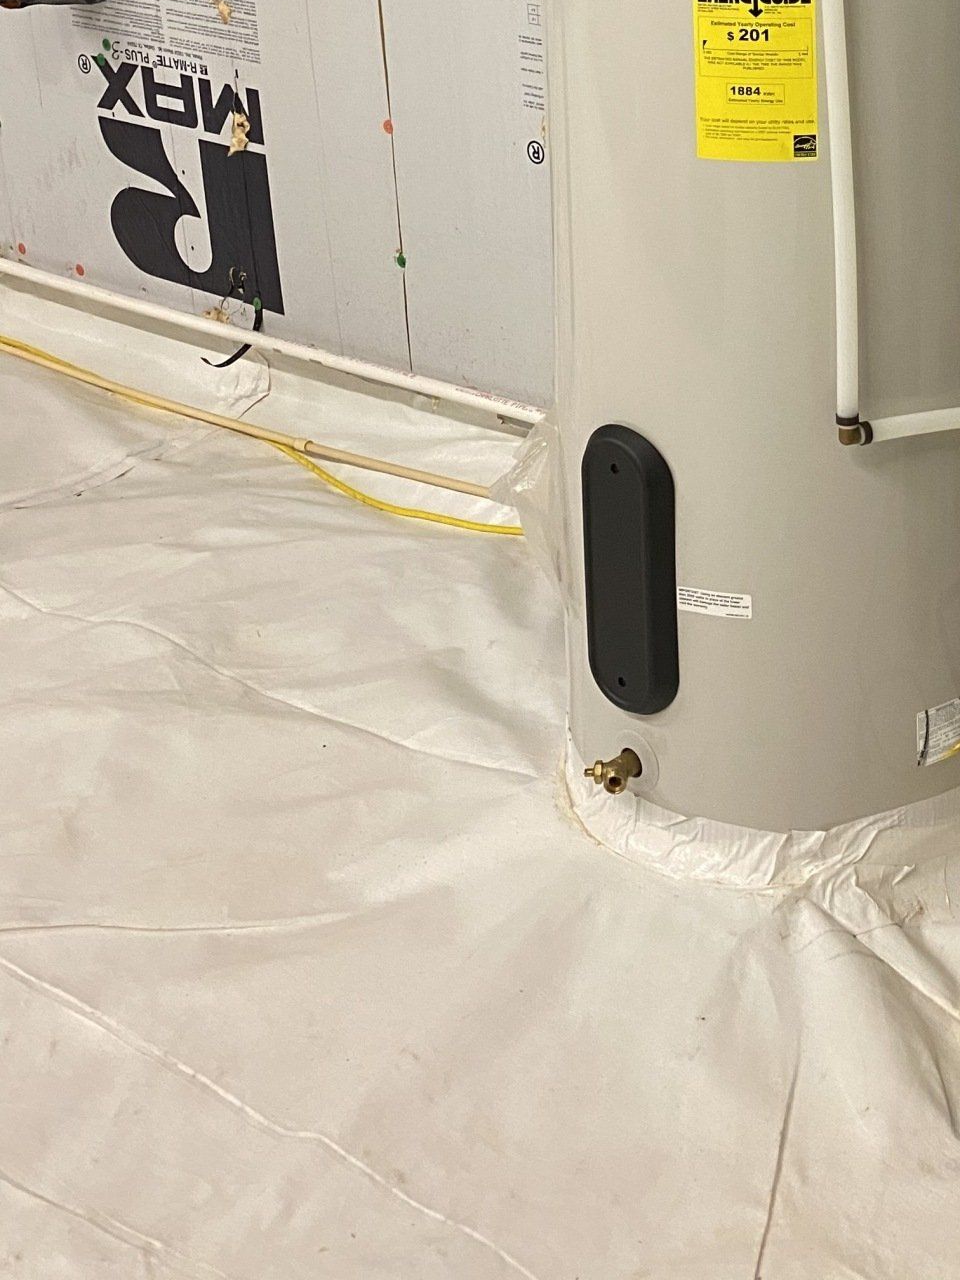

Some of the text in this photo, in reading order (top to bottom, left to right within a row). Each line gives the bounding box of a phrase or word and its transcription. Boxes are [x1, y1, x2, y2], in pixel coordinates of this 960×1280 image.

[727, 28, 769, 41] $ 201
[730, 86, 761, 96] 1884
